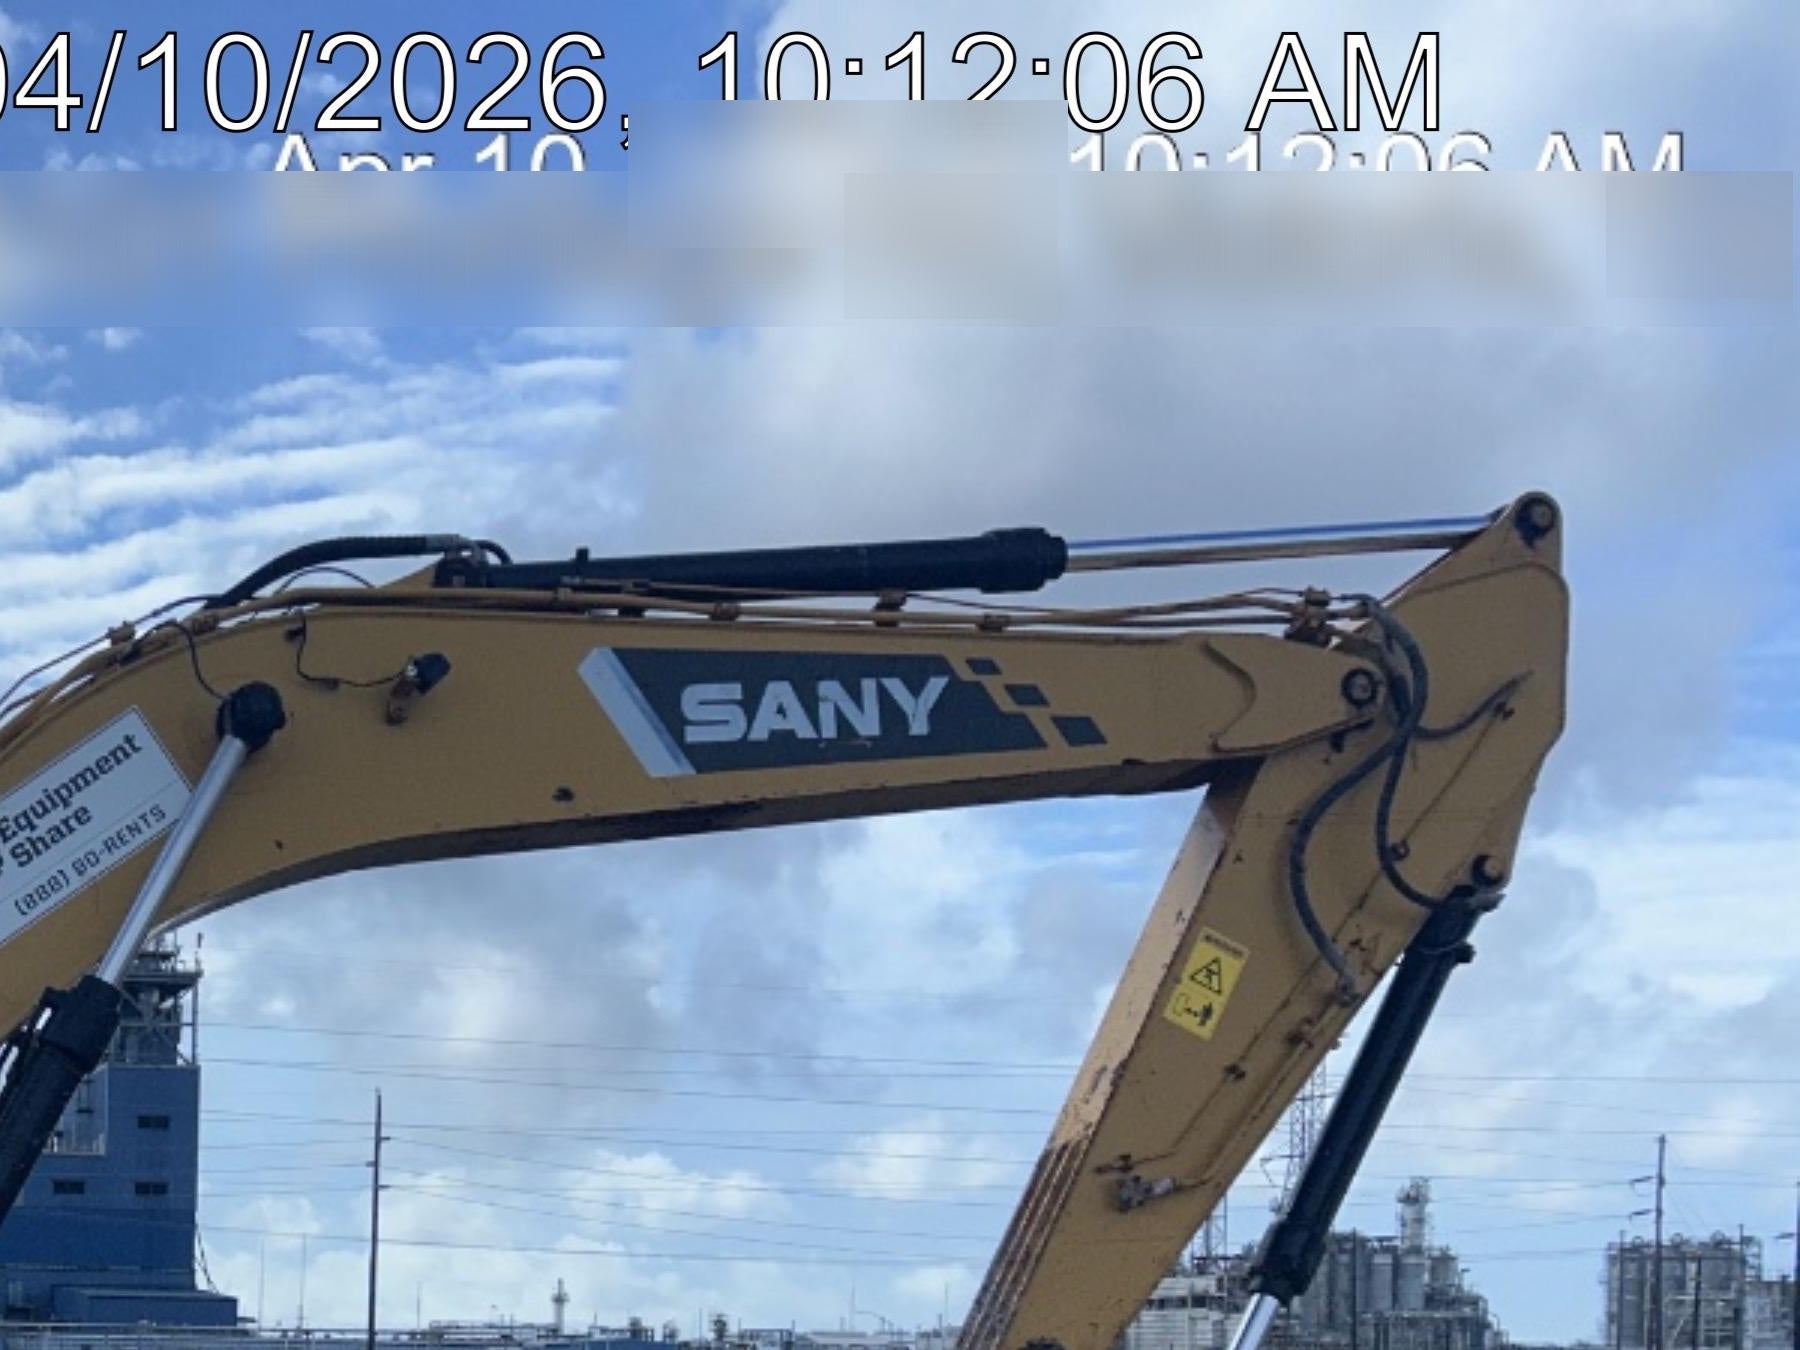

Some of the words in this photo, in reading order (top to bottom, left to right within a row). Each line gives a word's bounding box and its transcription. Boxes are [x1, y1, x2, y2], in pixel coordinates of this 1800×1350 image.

[679, 676, 950, 744] SANY
[8, 804, 94, 868] Share
[13, 868, 72, 916] (888)
